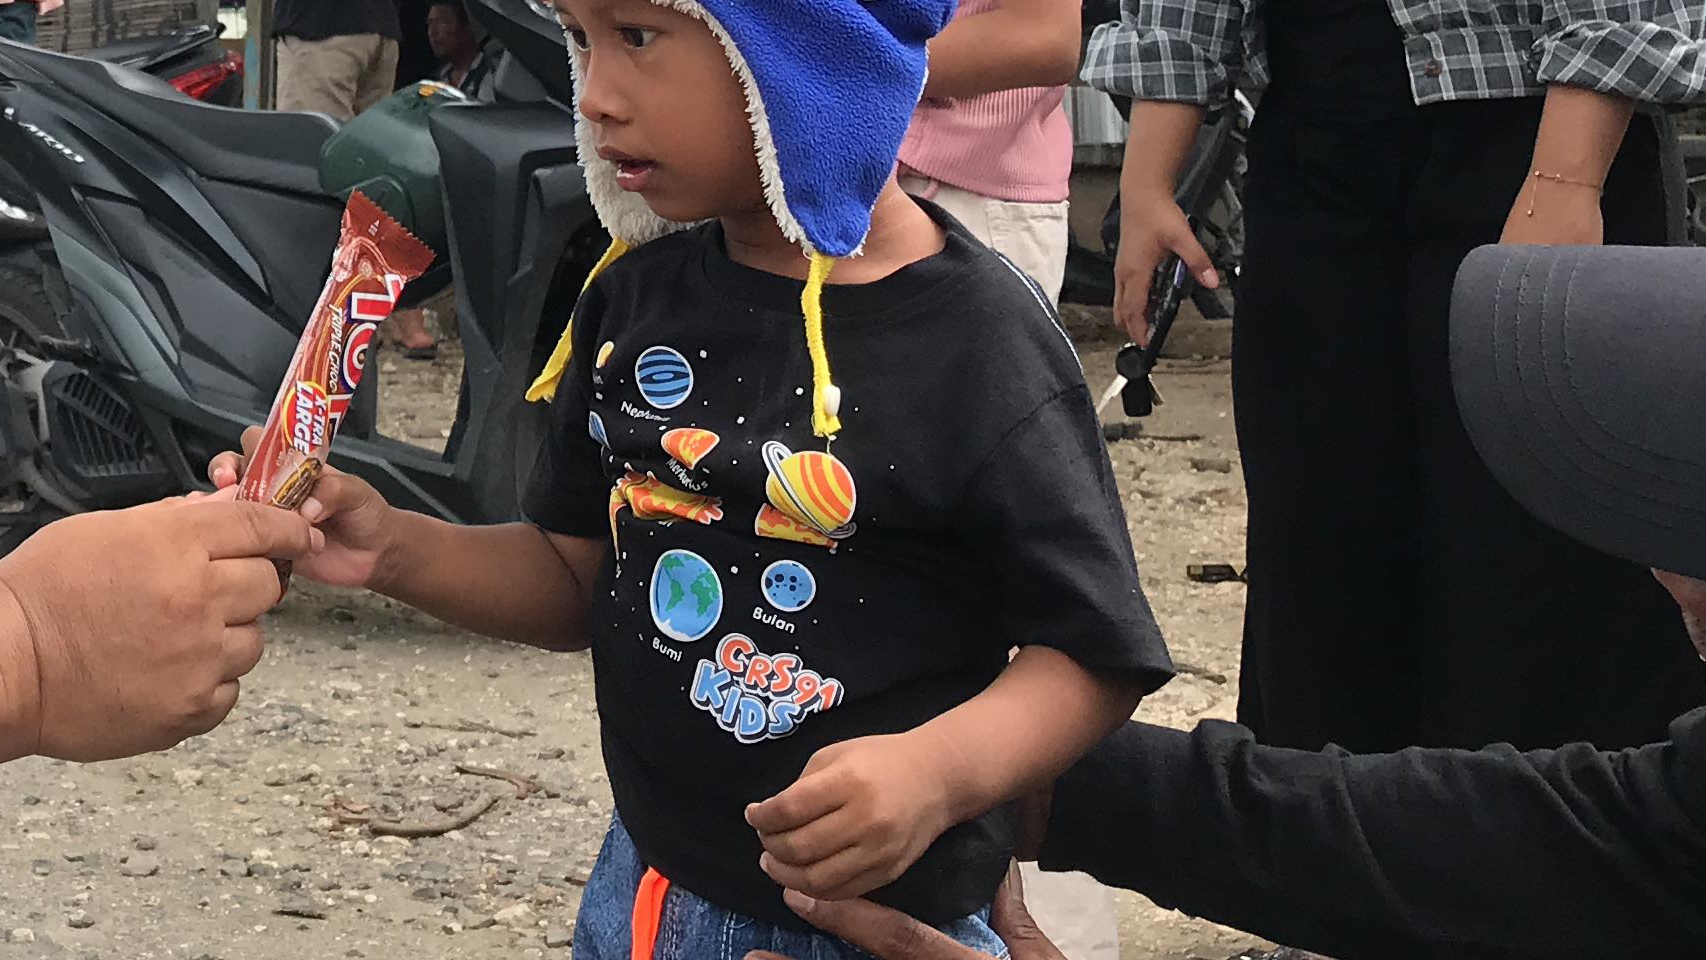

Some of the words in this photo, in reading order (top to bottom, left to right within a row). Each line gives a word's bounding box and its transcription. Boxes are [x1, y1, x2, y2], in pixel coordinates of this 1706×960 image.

[328, 304, 343, 355] TRIPLE
[328, 354, 341, 394] CHOC
[294, 380, 314, 456] LARGE
[312, 394, 327, 446] X-TRA
[753, 607, 795, 634] Bulan
[652, 637, 682, 662] Bumi
[720, 638, 839, 711] CRS91
[695, 661, 802, 736] KIDS
